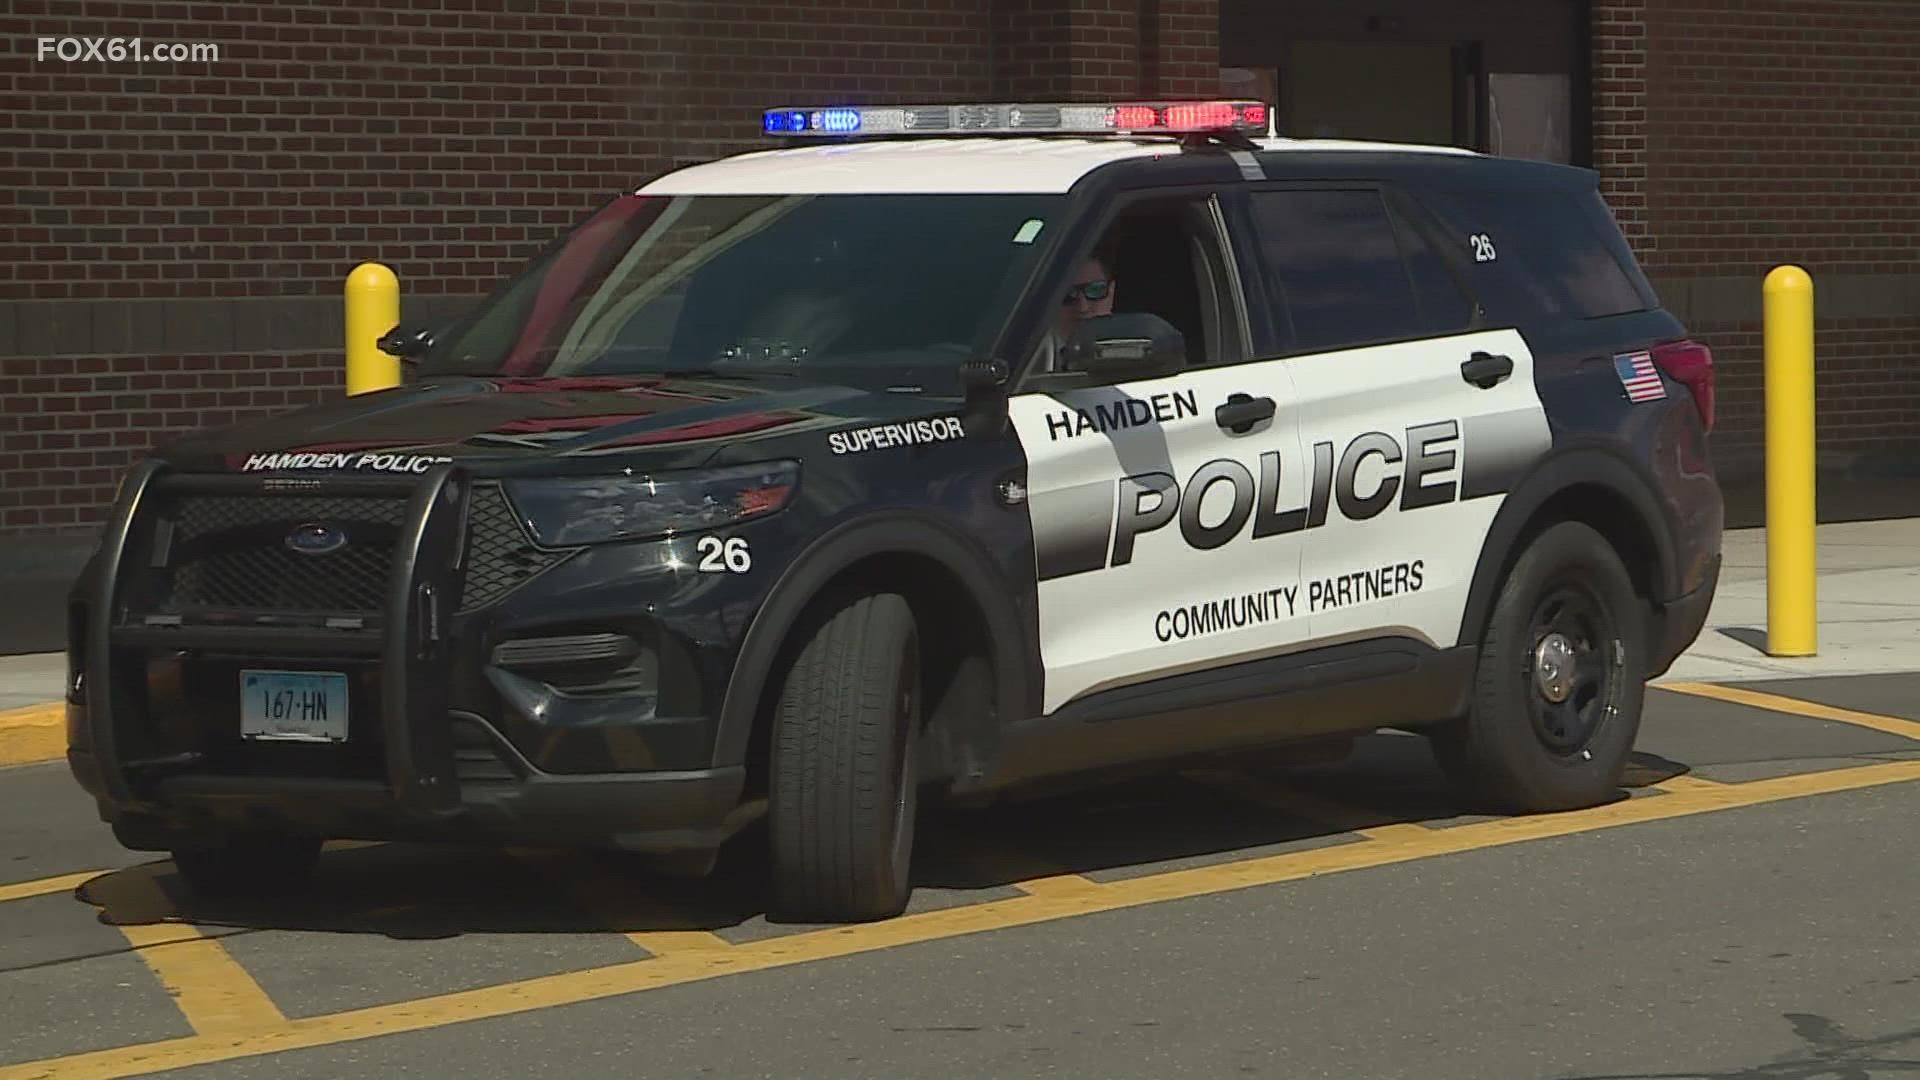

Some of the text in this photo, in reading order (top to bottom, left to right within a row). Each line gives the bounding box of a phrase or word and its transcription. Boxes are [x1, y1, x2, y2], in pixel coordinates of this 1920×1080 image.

[1470, 234, 1496, 262] 26
[1046, 389, 1198, 440] HAMDEN
[828, 416, 965, 454] SUPERVISOR
[242, 452, 453, 473] HAMDEN POLIC
[1111, 419, 1460, 567] POLICE
[697, 536, 751, 573] 26
[1155, 560, 1424, 642] COMMUNITY PARTNERS
